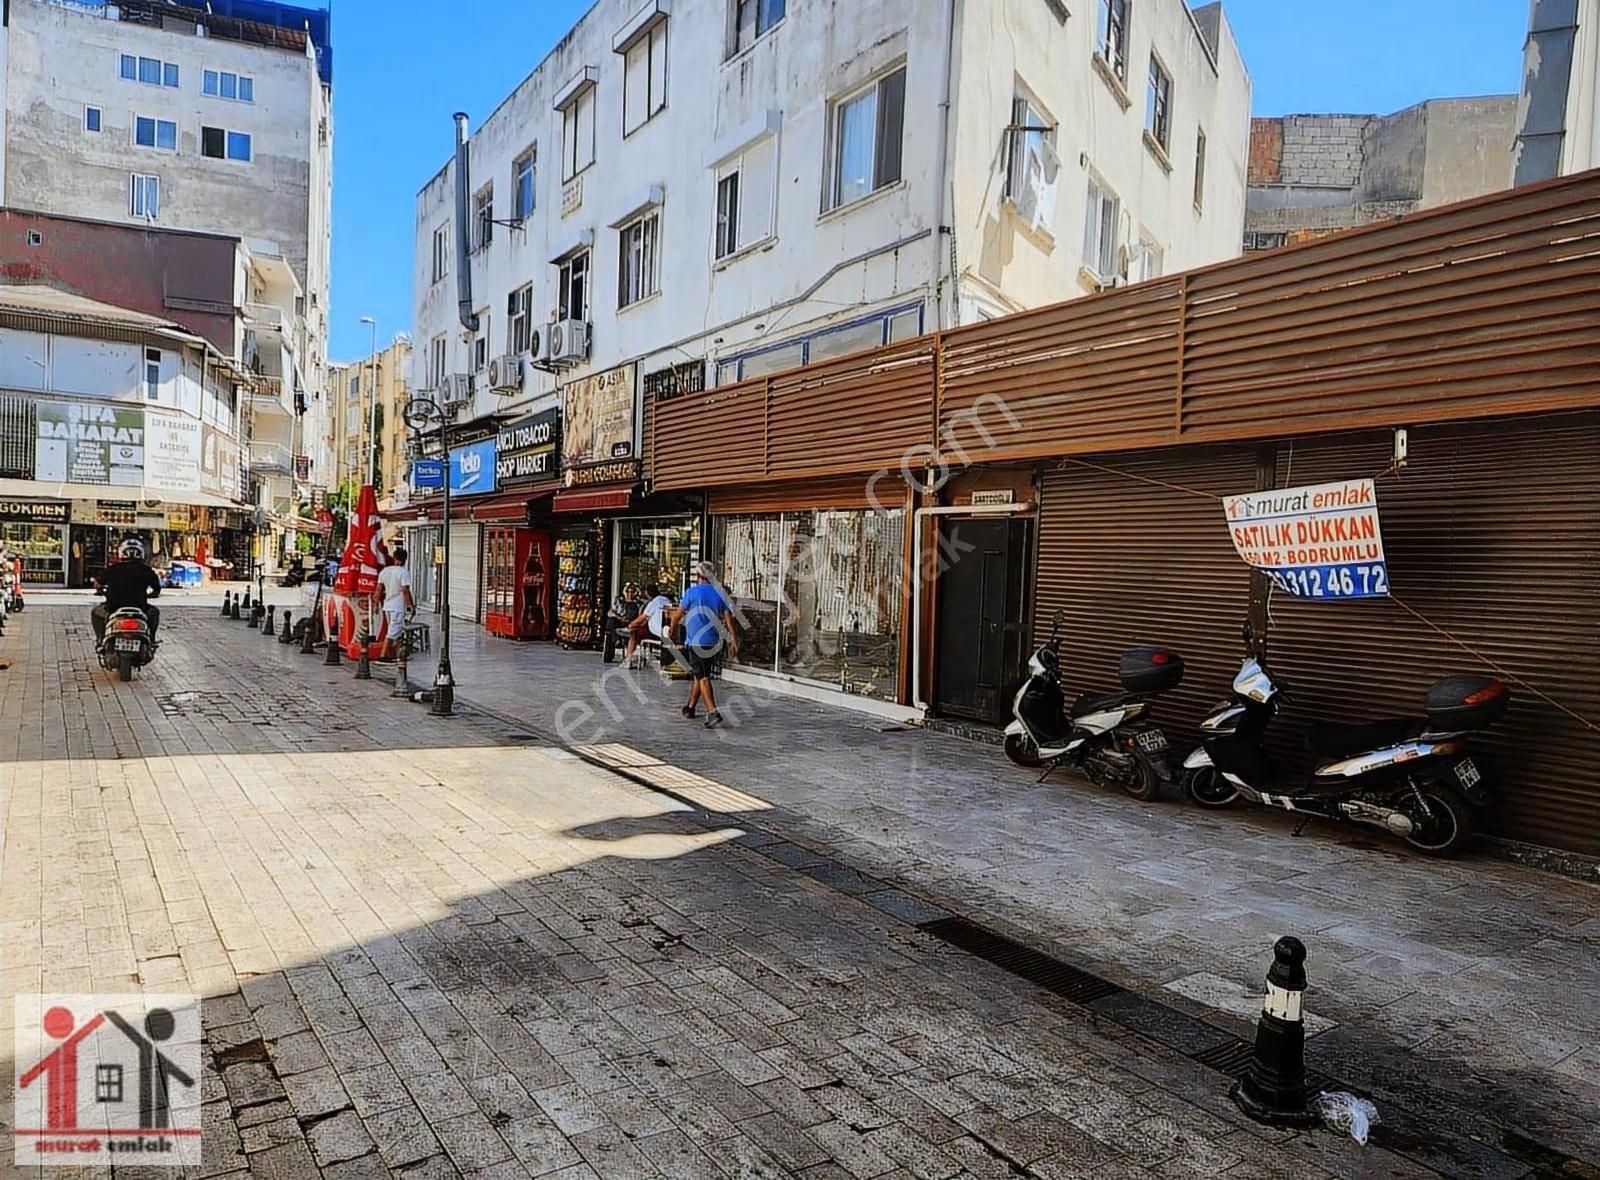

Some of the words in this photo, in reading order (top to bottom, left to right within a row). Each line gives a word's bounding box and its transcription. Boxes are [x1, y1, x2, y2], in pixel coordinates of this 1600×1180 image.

[38, 421, 144, 444] BAHARAT
[515, 422, 549, 448] TOBACCO
[496, 458, 515, 478] SHOP
[515, 453, 547, 475] MARKET
[1256, 491, 1309, 515] murat
[1312, 482, 1371, 509] emlak
[1234, 522, 1293, 548] SATILIK
[1297, 514, 1376, 545] DÜKKAN
